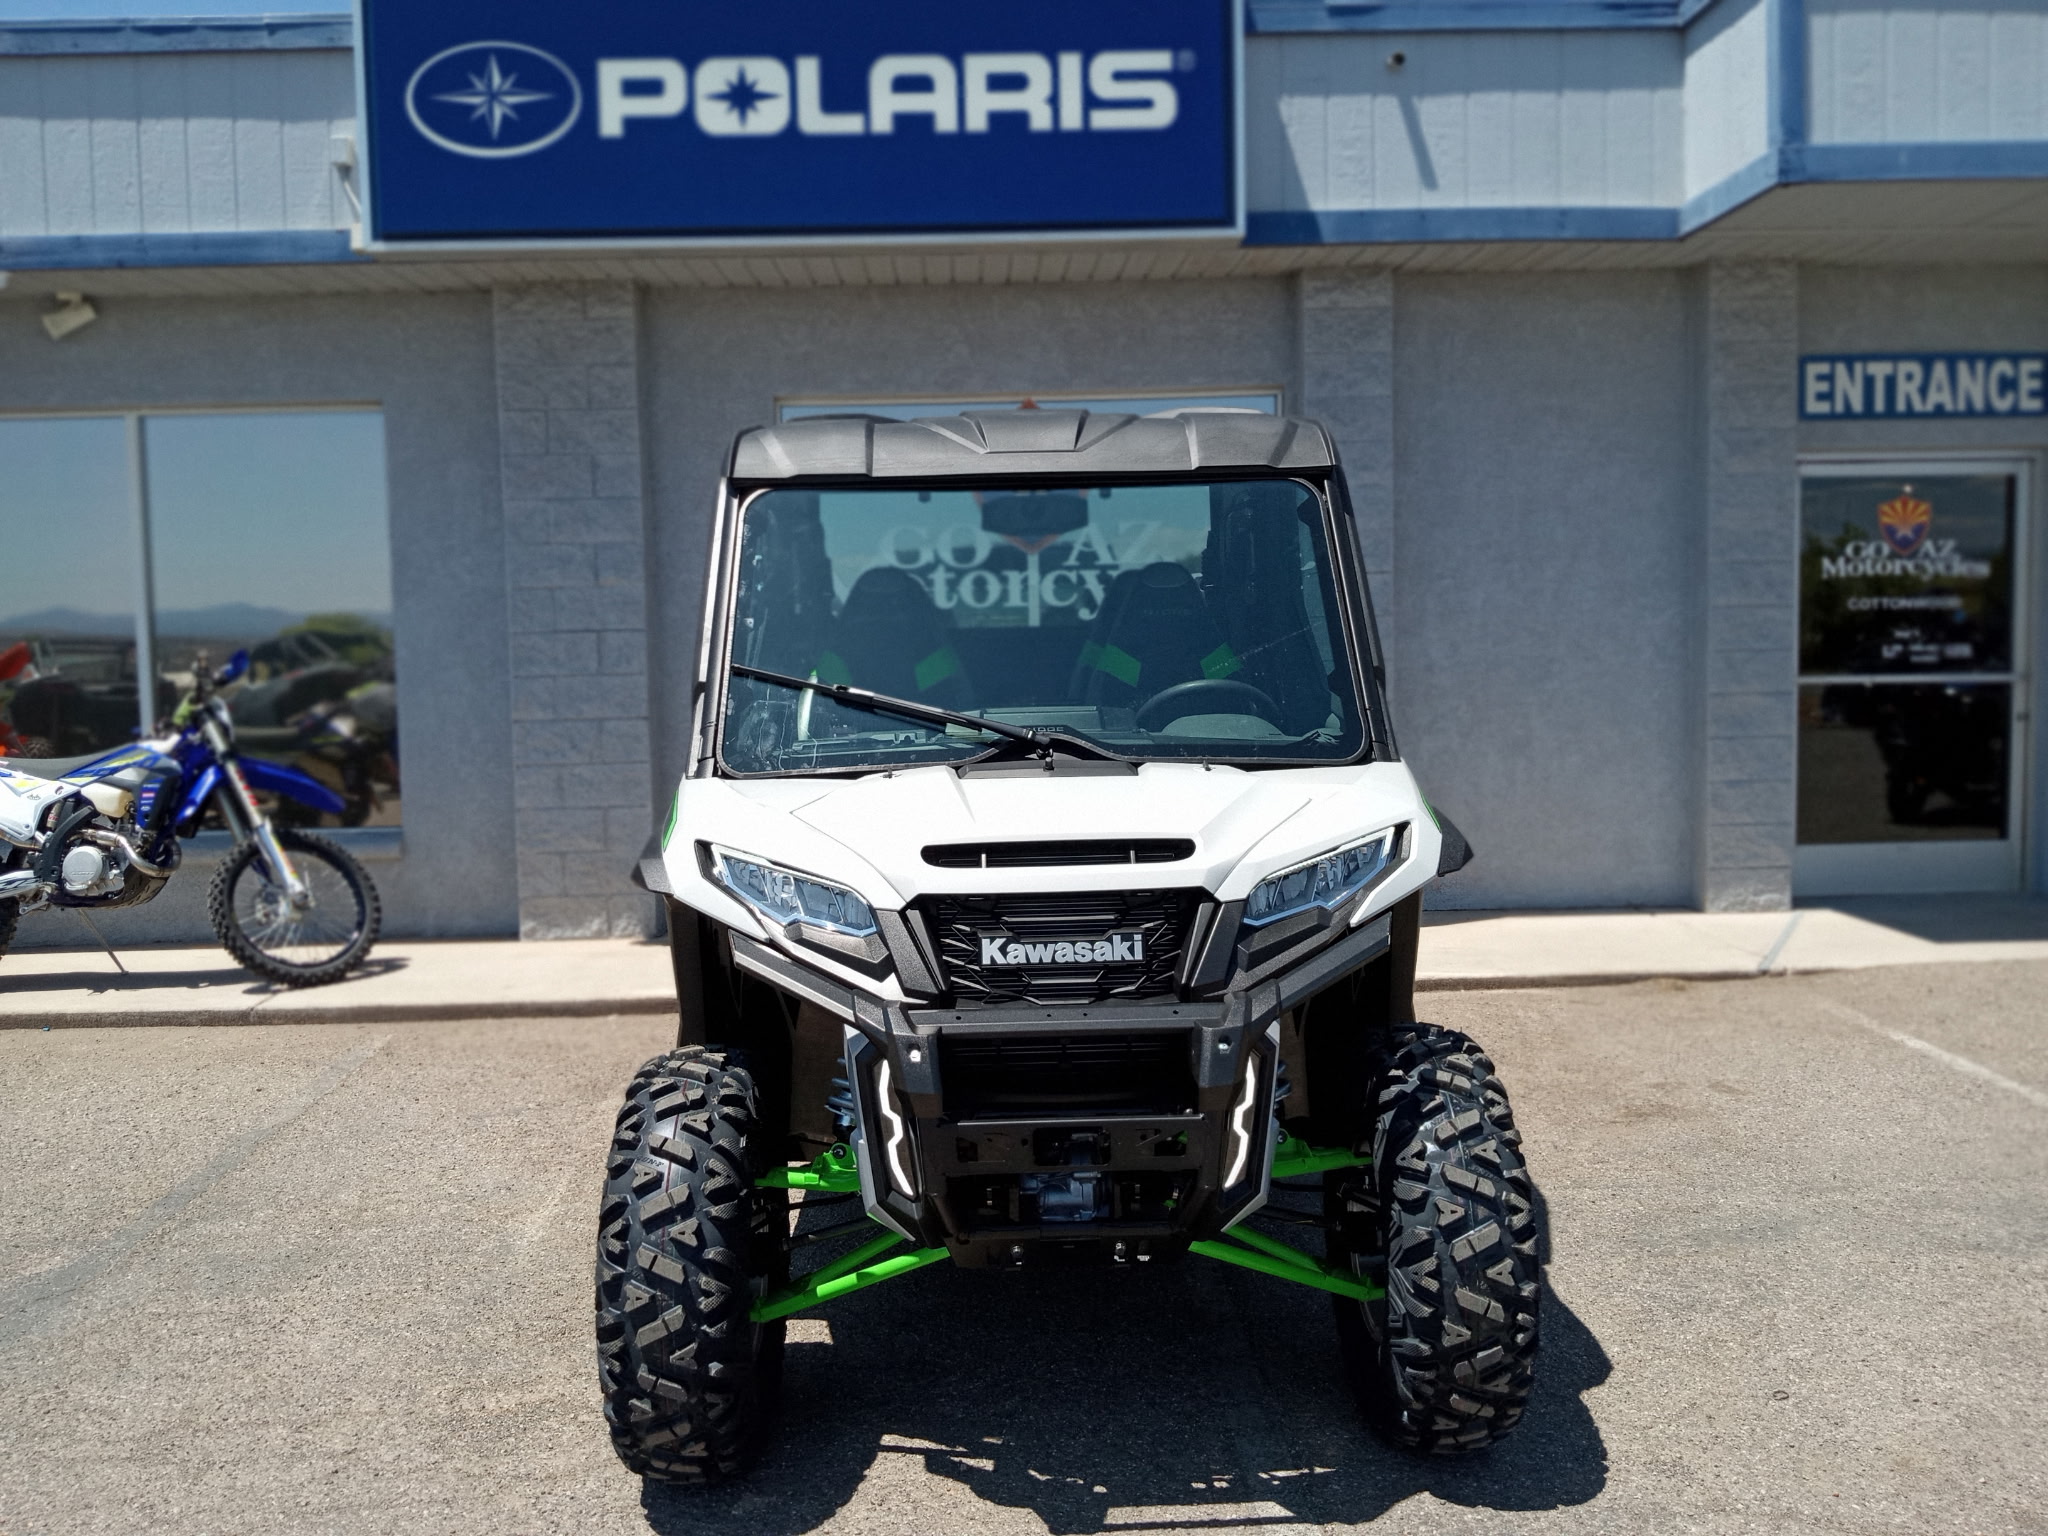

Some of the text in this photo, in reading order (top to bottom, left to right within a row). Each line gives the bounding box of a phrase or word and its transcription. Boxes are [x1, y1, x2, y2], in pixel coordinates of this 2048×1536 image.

[597, 51, 1179, 137] POLARIS
[1804, 359, 2044, 416] ENTRANCE
[879, 521, 1176, 569] GO AZ
[981, 934, 1143, 965] Kawasaki
